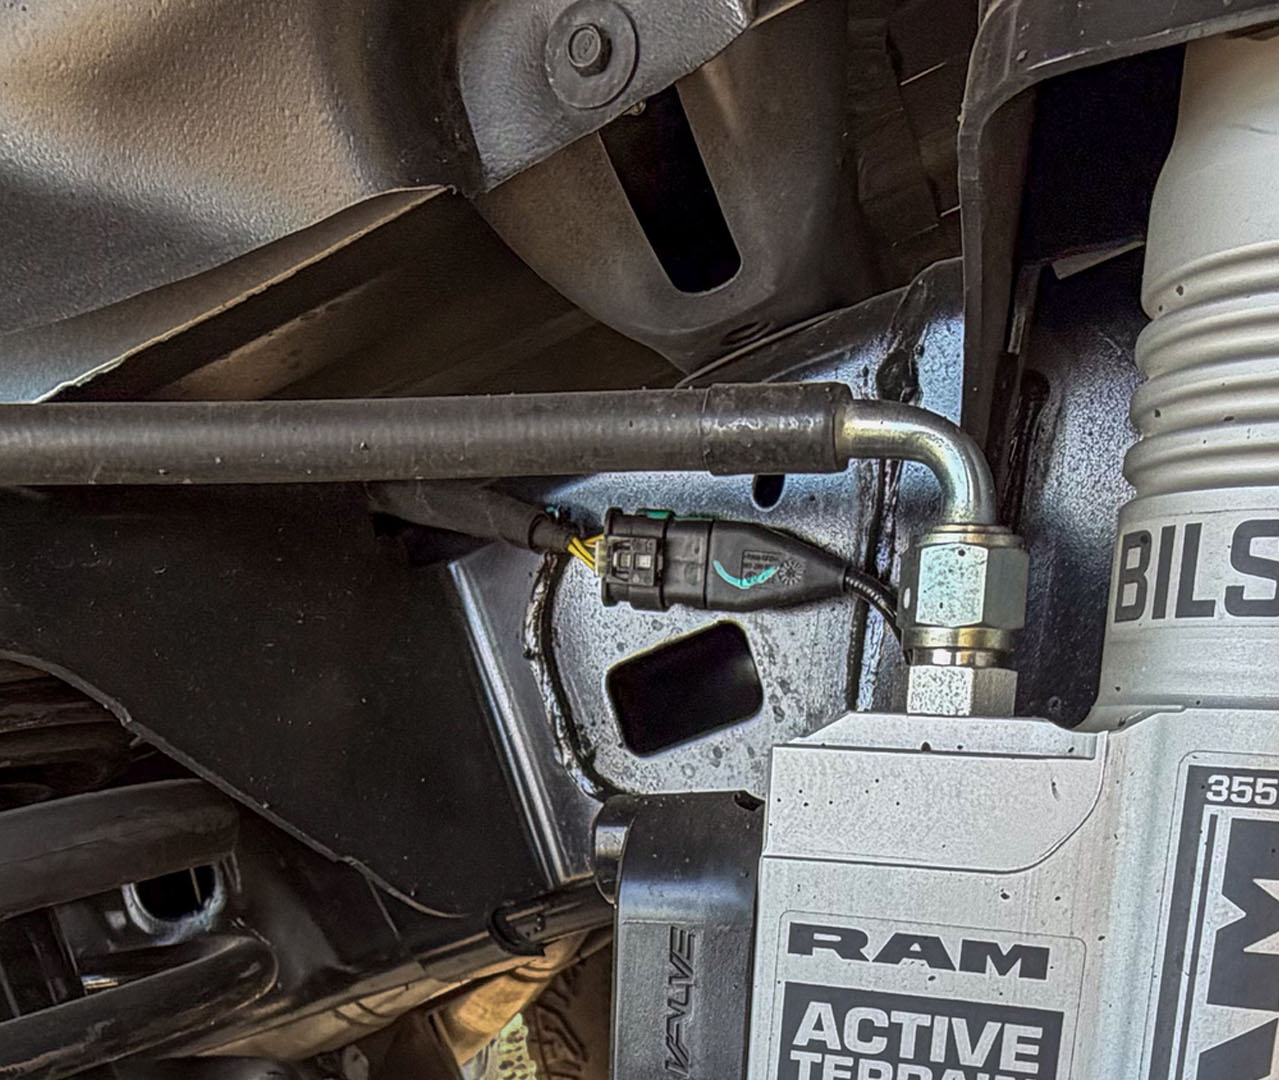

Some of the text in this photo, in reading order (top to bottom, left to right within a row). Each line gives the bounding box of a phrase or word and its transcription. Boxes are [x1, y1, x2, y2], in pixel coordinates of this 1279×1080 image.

[1206, 774, 1279, 805] 355
[787, 922, 1050, 980] RAM
[665, 925, 696, 1079] VALVE
[792, 1001, 1043, 1074] ACTIVE
